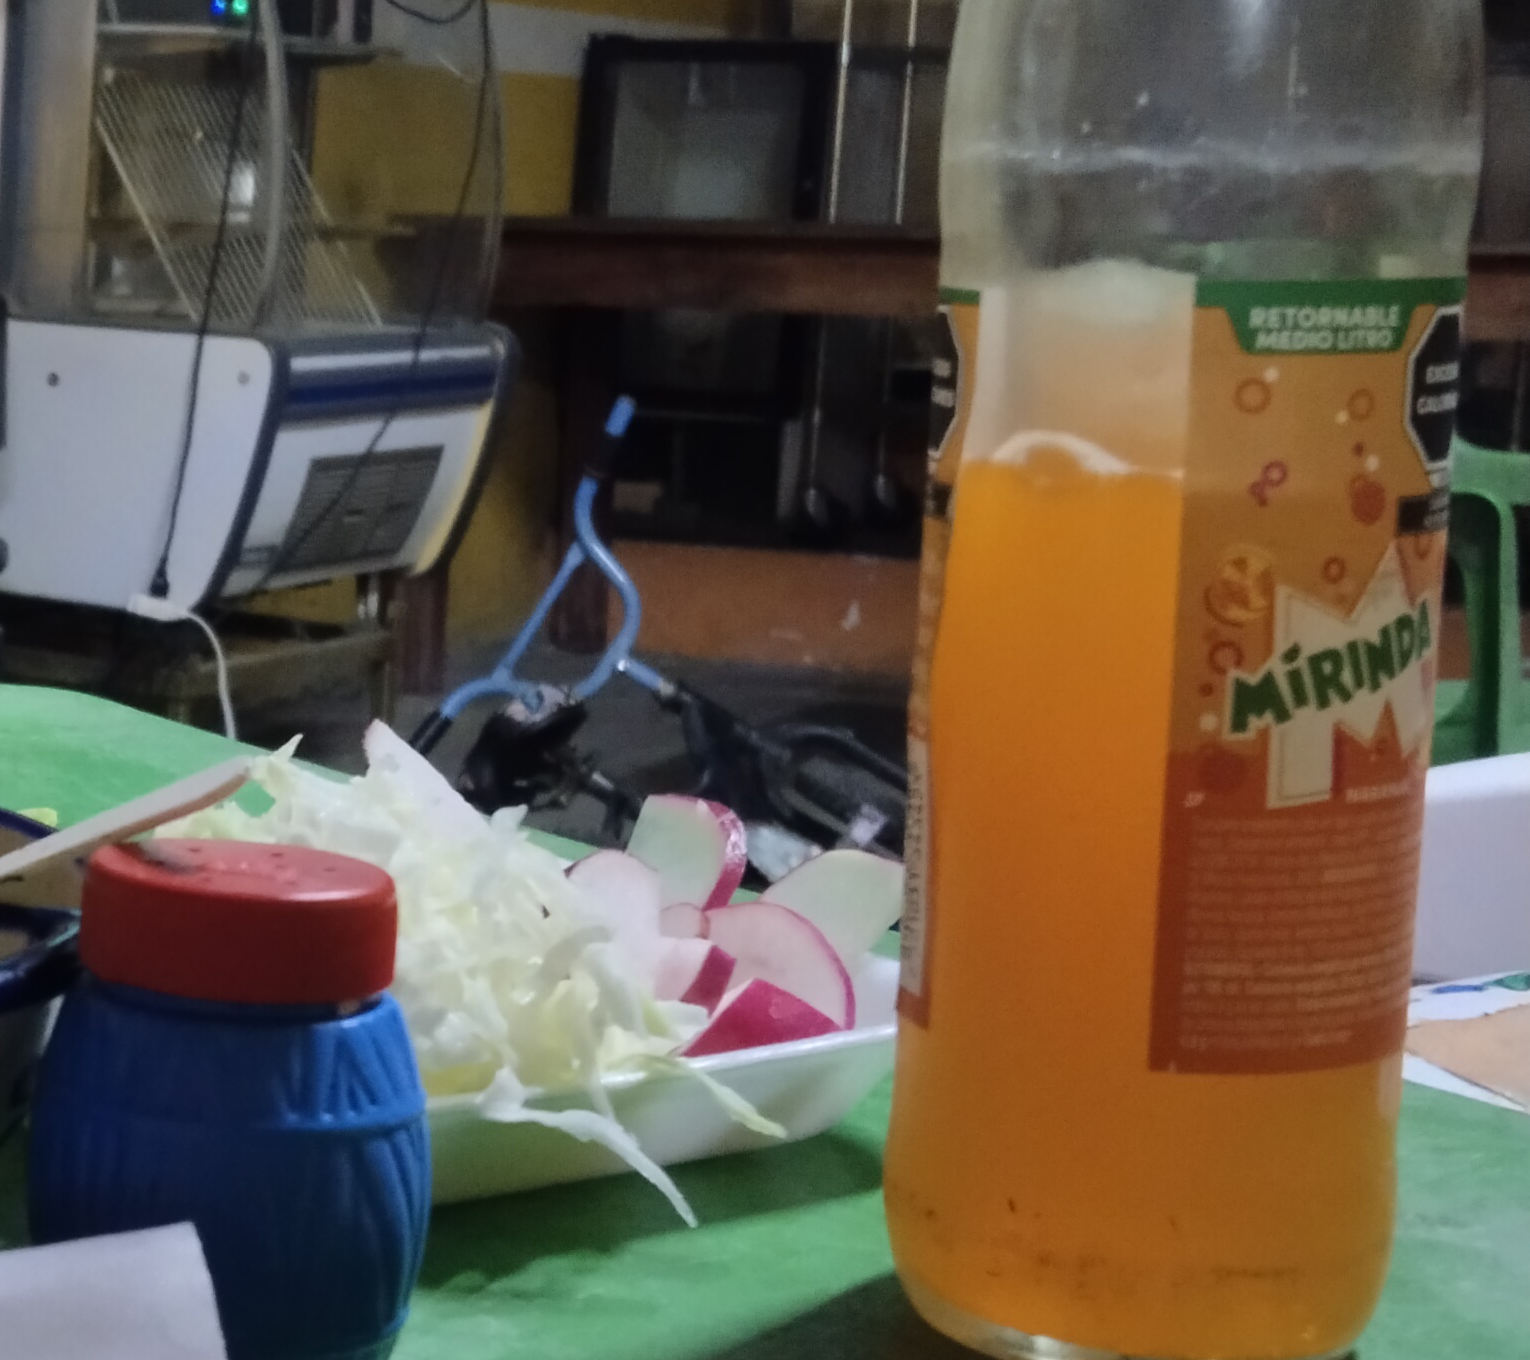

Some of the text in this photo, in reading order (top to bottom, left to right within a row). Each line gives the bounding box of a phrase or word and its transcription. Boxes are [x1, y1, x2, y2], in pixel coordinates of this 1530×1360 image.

[1249, 304, 1400, 329] RETORNABLE
[1254, 327, 1394, 351] MEDIO LITRO
